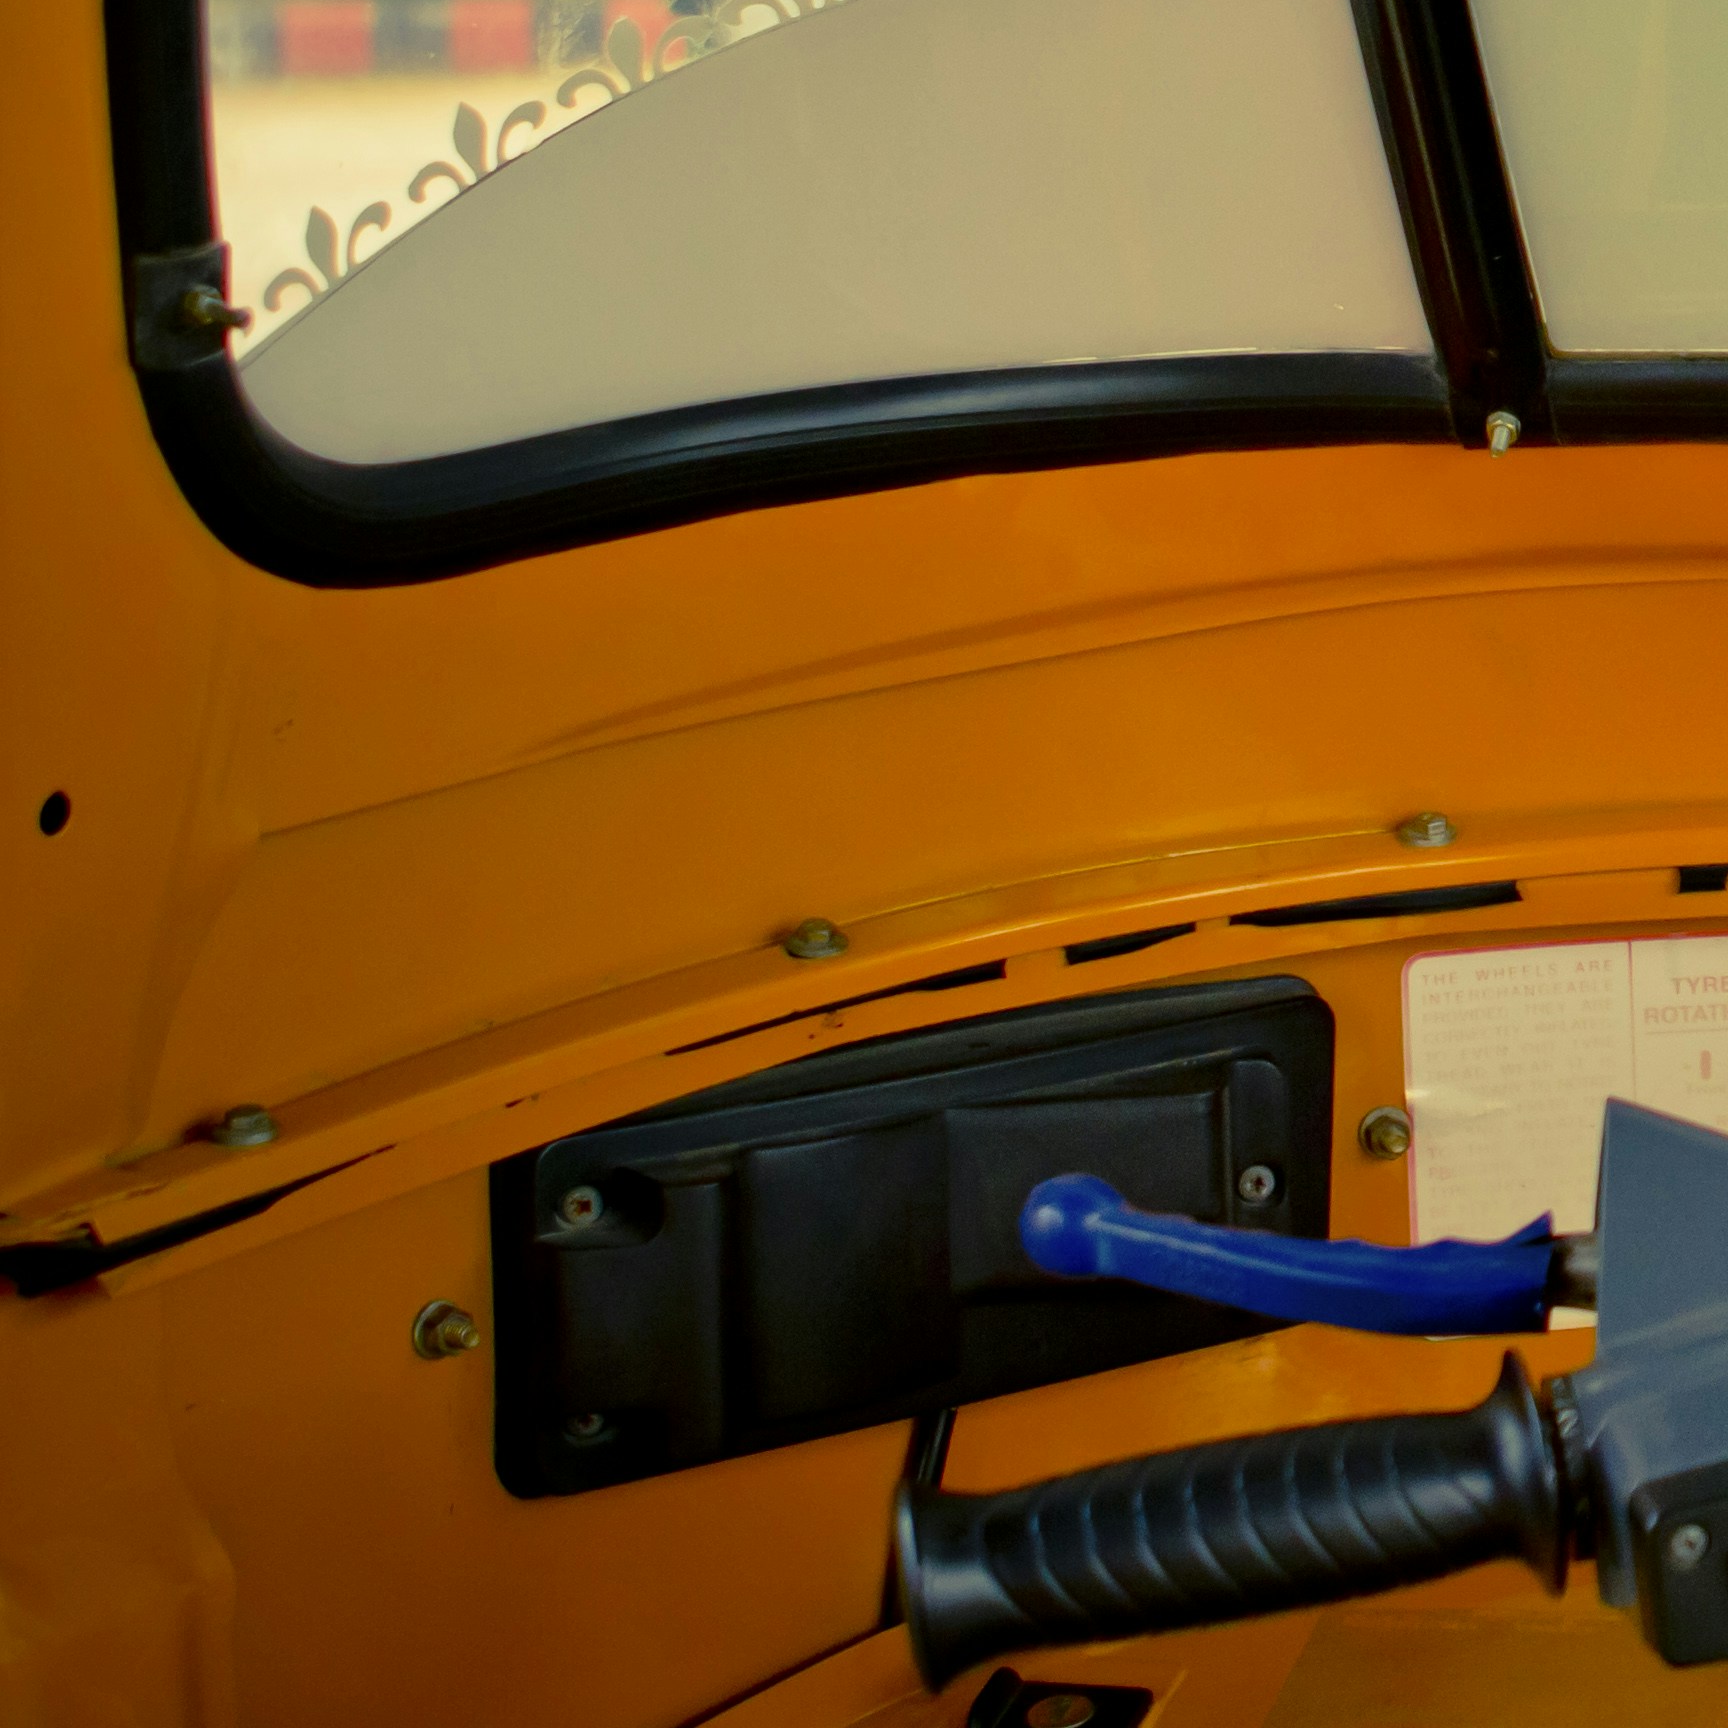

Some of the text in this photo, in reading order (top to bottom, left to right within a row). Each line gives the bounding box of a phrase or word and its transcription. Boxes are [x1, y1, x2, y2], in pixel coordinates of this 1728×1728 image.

[1421, 959, 1613, 986] THE WHEELS ARE
